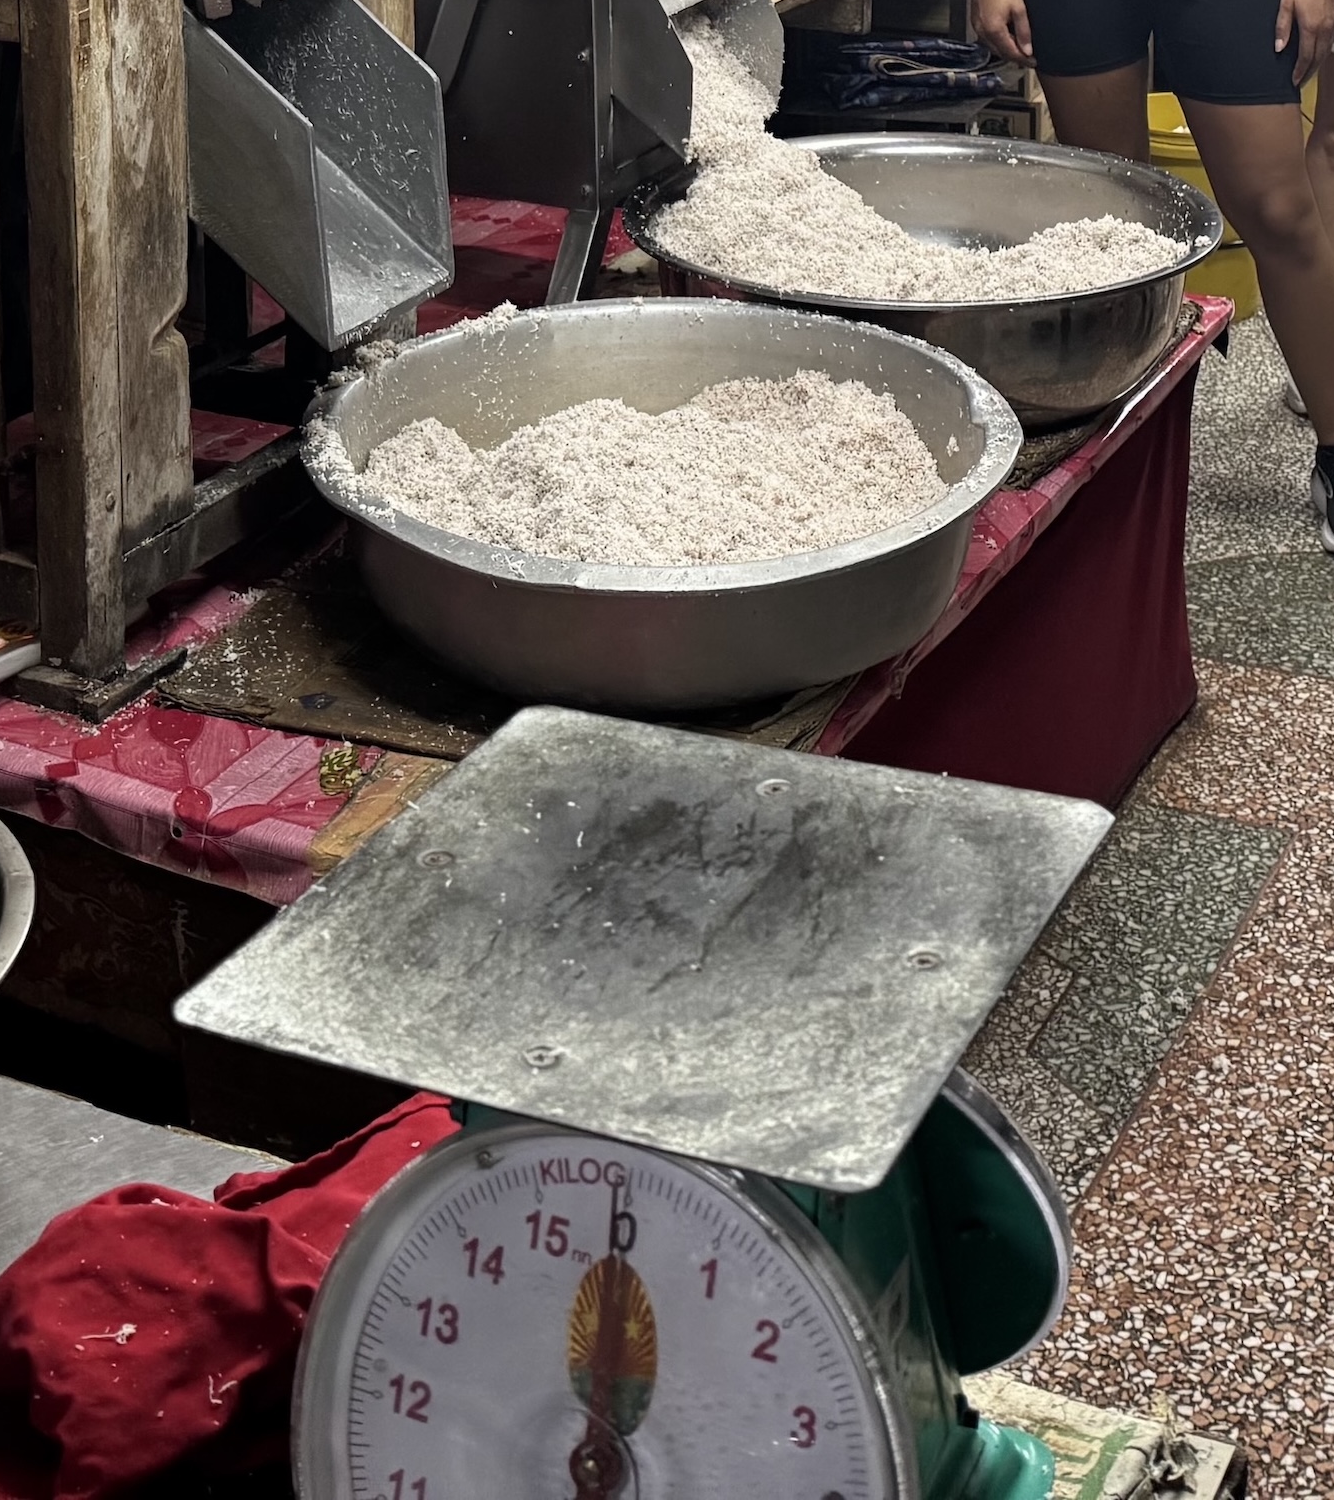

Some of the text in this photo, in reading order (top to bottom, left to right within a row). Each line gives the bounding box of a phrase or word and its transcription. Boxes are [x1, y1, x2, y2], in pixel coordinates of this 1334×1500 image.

[539, 1158, 627, 1187] KILOG
[525, 1209, 570, 1257] 15
[463, 1236, 506, 1285] 14
[700, 1257, 718, 1299] 1
[416, 1297, 460, 1345] 13
[751, 1319, 781, 1364] 2
[389, 1373, 432, 1424] 12
[790, 1404, 817, 1449] 3
